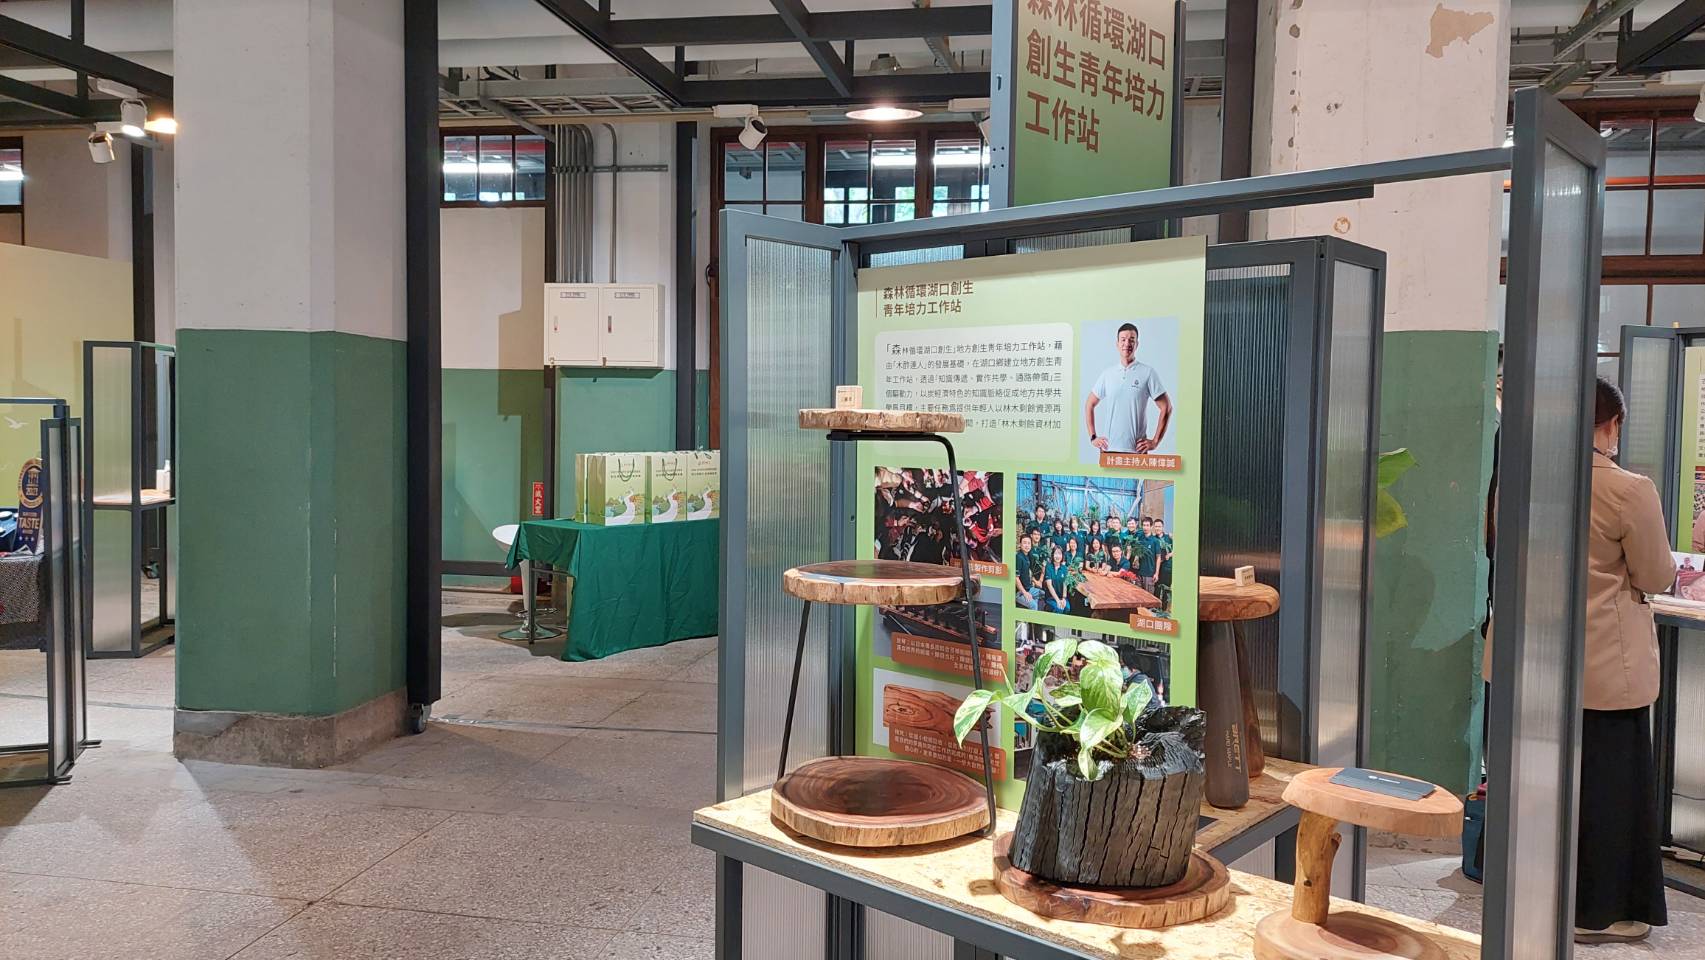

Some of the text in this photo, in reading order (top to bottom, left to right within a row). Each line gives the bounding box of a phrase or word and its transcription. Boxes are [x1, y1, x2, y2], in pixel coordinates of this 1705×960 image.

[1026, 28, 1166, 121] 創生青年培力
[1025, 90, 1100, 153] 工作站
[883, 280, 974, 300] 森林循環湖口創生
[883, 299, 962, 317] 青年培力工作站
[19, 517, 40, 530] TASTE
